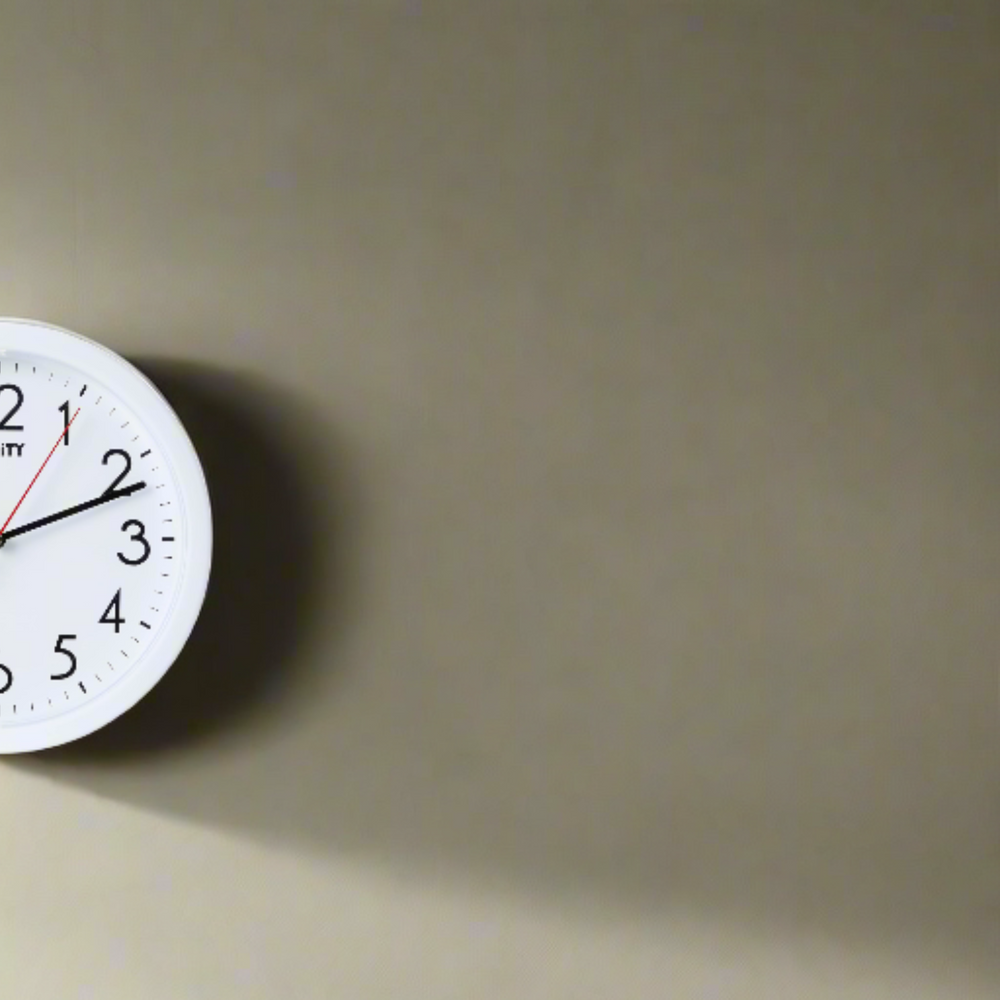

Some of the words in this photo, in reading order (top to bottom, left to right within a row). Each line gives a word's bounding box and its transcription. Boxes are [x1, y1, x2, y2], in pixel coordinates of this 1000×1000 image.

[58, 400, 71, 446] 1
[102, 449, 132, 495] 2
[117, 519, 151, 565] 3
[99, 588, 126, 633] 4
[50, 635, 77, 681] 5
